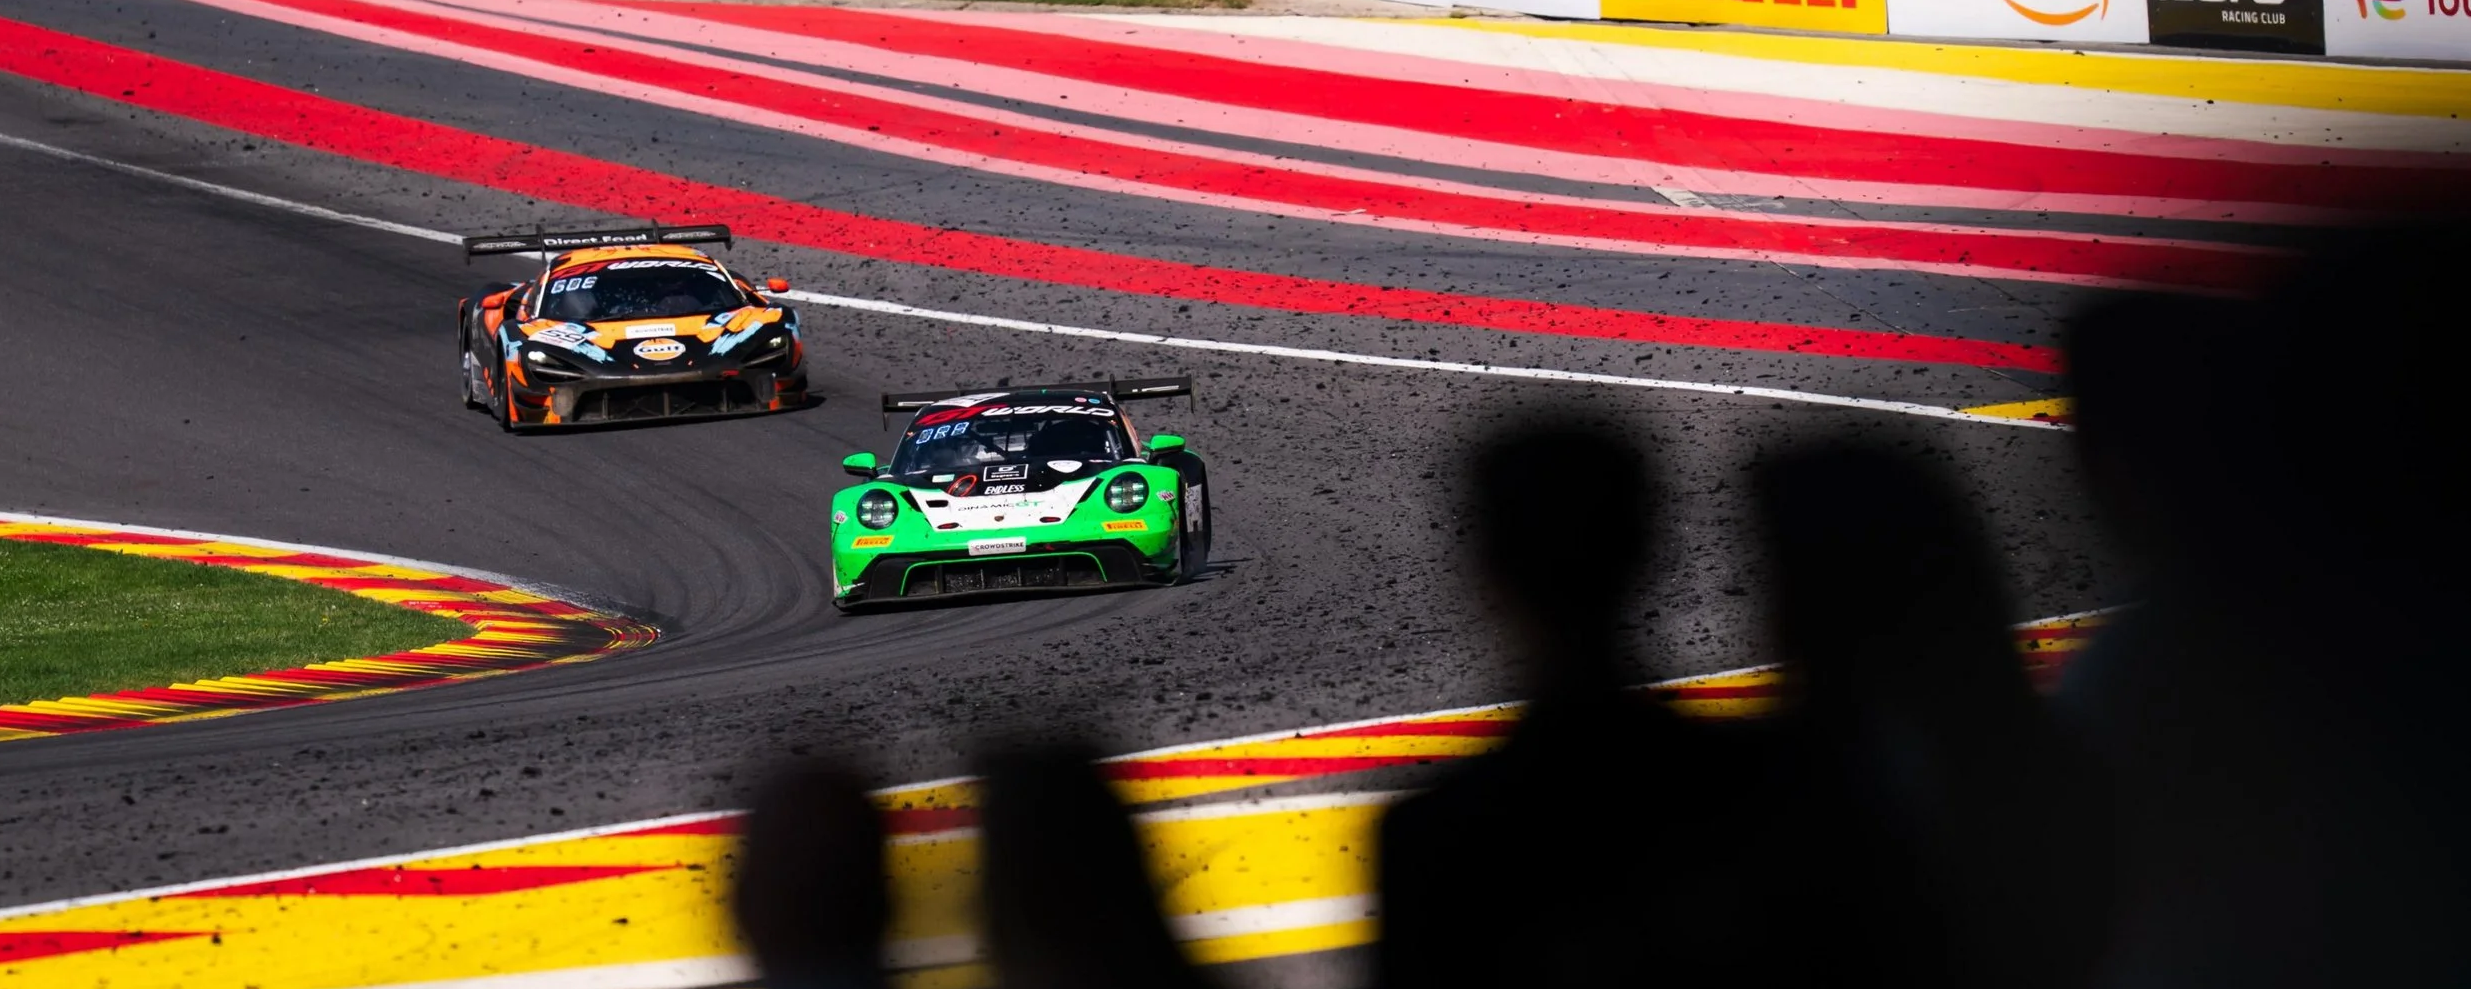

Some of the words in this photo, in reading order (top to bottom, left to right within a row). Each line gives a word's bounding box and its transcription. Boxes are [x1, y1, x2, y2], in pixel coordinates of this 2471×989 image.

[2221, 10, 2259, 23] RACING
[2261, 12, 2286, 24] CLUB
[543, 237, 598, 246] Direct
[602, 233, 647, 243] Food
[607, 260, 719, 271] WORLD
[638, 345, 682, 353] Gulf
[981, 405, 1115, 417] WORLD
[984, 484, 1025, 495] ENDLESS
[975, 541, 1024, 550] CROWDSTRIKE
